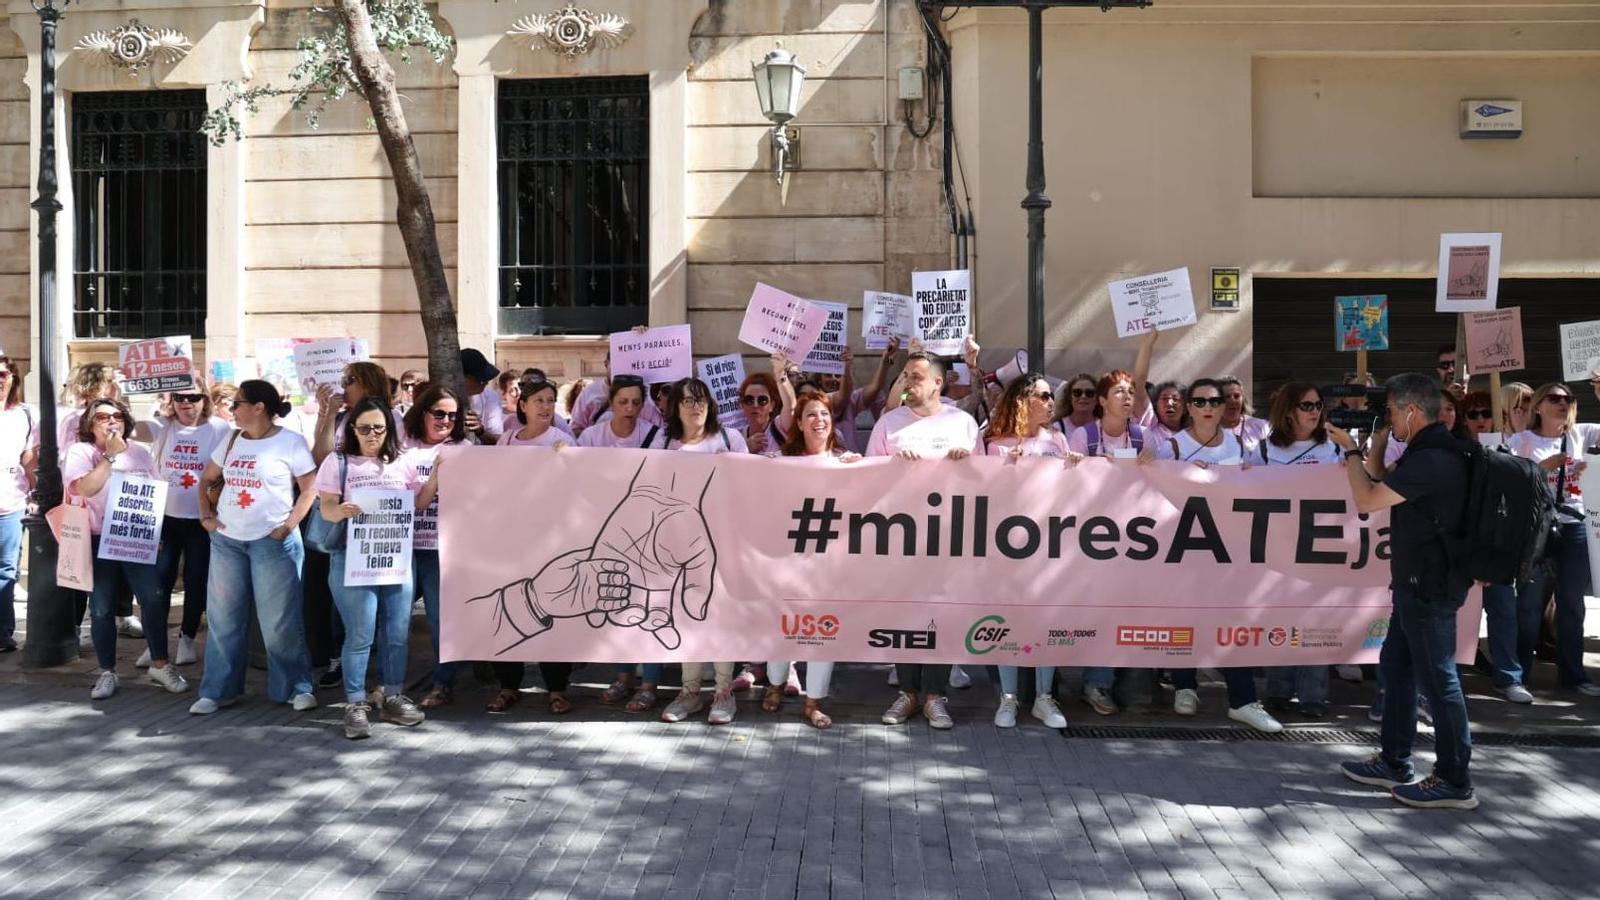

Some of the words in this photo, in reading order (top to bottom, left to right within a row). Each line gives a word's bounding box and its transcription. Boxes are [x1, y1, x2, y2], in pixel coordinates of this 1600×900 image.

[936, 278, 947, 290] LA
[916, 289, 967, 303] PRECARIETAT
[922, 303, 934, 315] NO
[936, 302, 964, 315] EDUCA:
[869, 325, 889, 336] ATE
[1126, 318, 1151, 333] ATE
[126, 339, 169, 361] ATE
[128, 362, 148, 378] 12
[151, 360, 185, 373] mesos
[721, 360, 736, 372] risc
[128, 378, 160, 391] 6638
[711, 378, 720, 388] es
[173, 446, 199, 454] ATE
[229, 460, 257, 469] ATE
[121, 481, 138, 495] Una
[140, 484, 156, 498] ATE
[112, 510, 129, 522] una
[130, 512, 156, 526] escola
[352, 510, 412, 525] Administració
[110, 523, 129, 537] més
[130, 525, 155, 540] forta!
[354, 528, 366, 539] no
[369, 525, 409, 539] reconeix
[787, 492, 1392, 570] #milloresATEja
[361, 541, 370, 554] la
[373, 541, 401, 554] meva
[367, 555, 393, 568] feina
[781, 614, 840, 636] USO
[974, 627, 1011, 641] CSIF
[1121, 630, 1170, 642] CCOO
[1216, 627, 1264, 647] UGT
